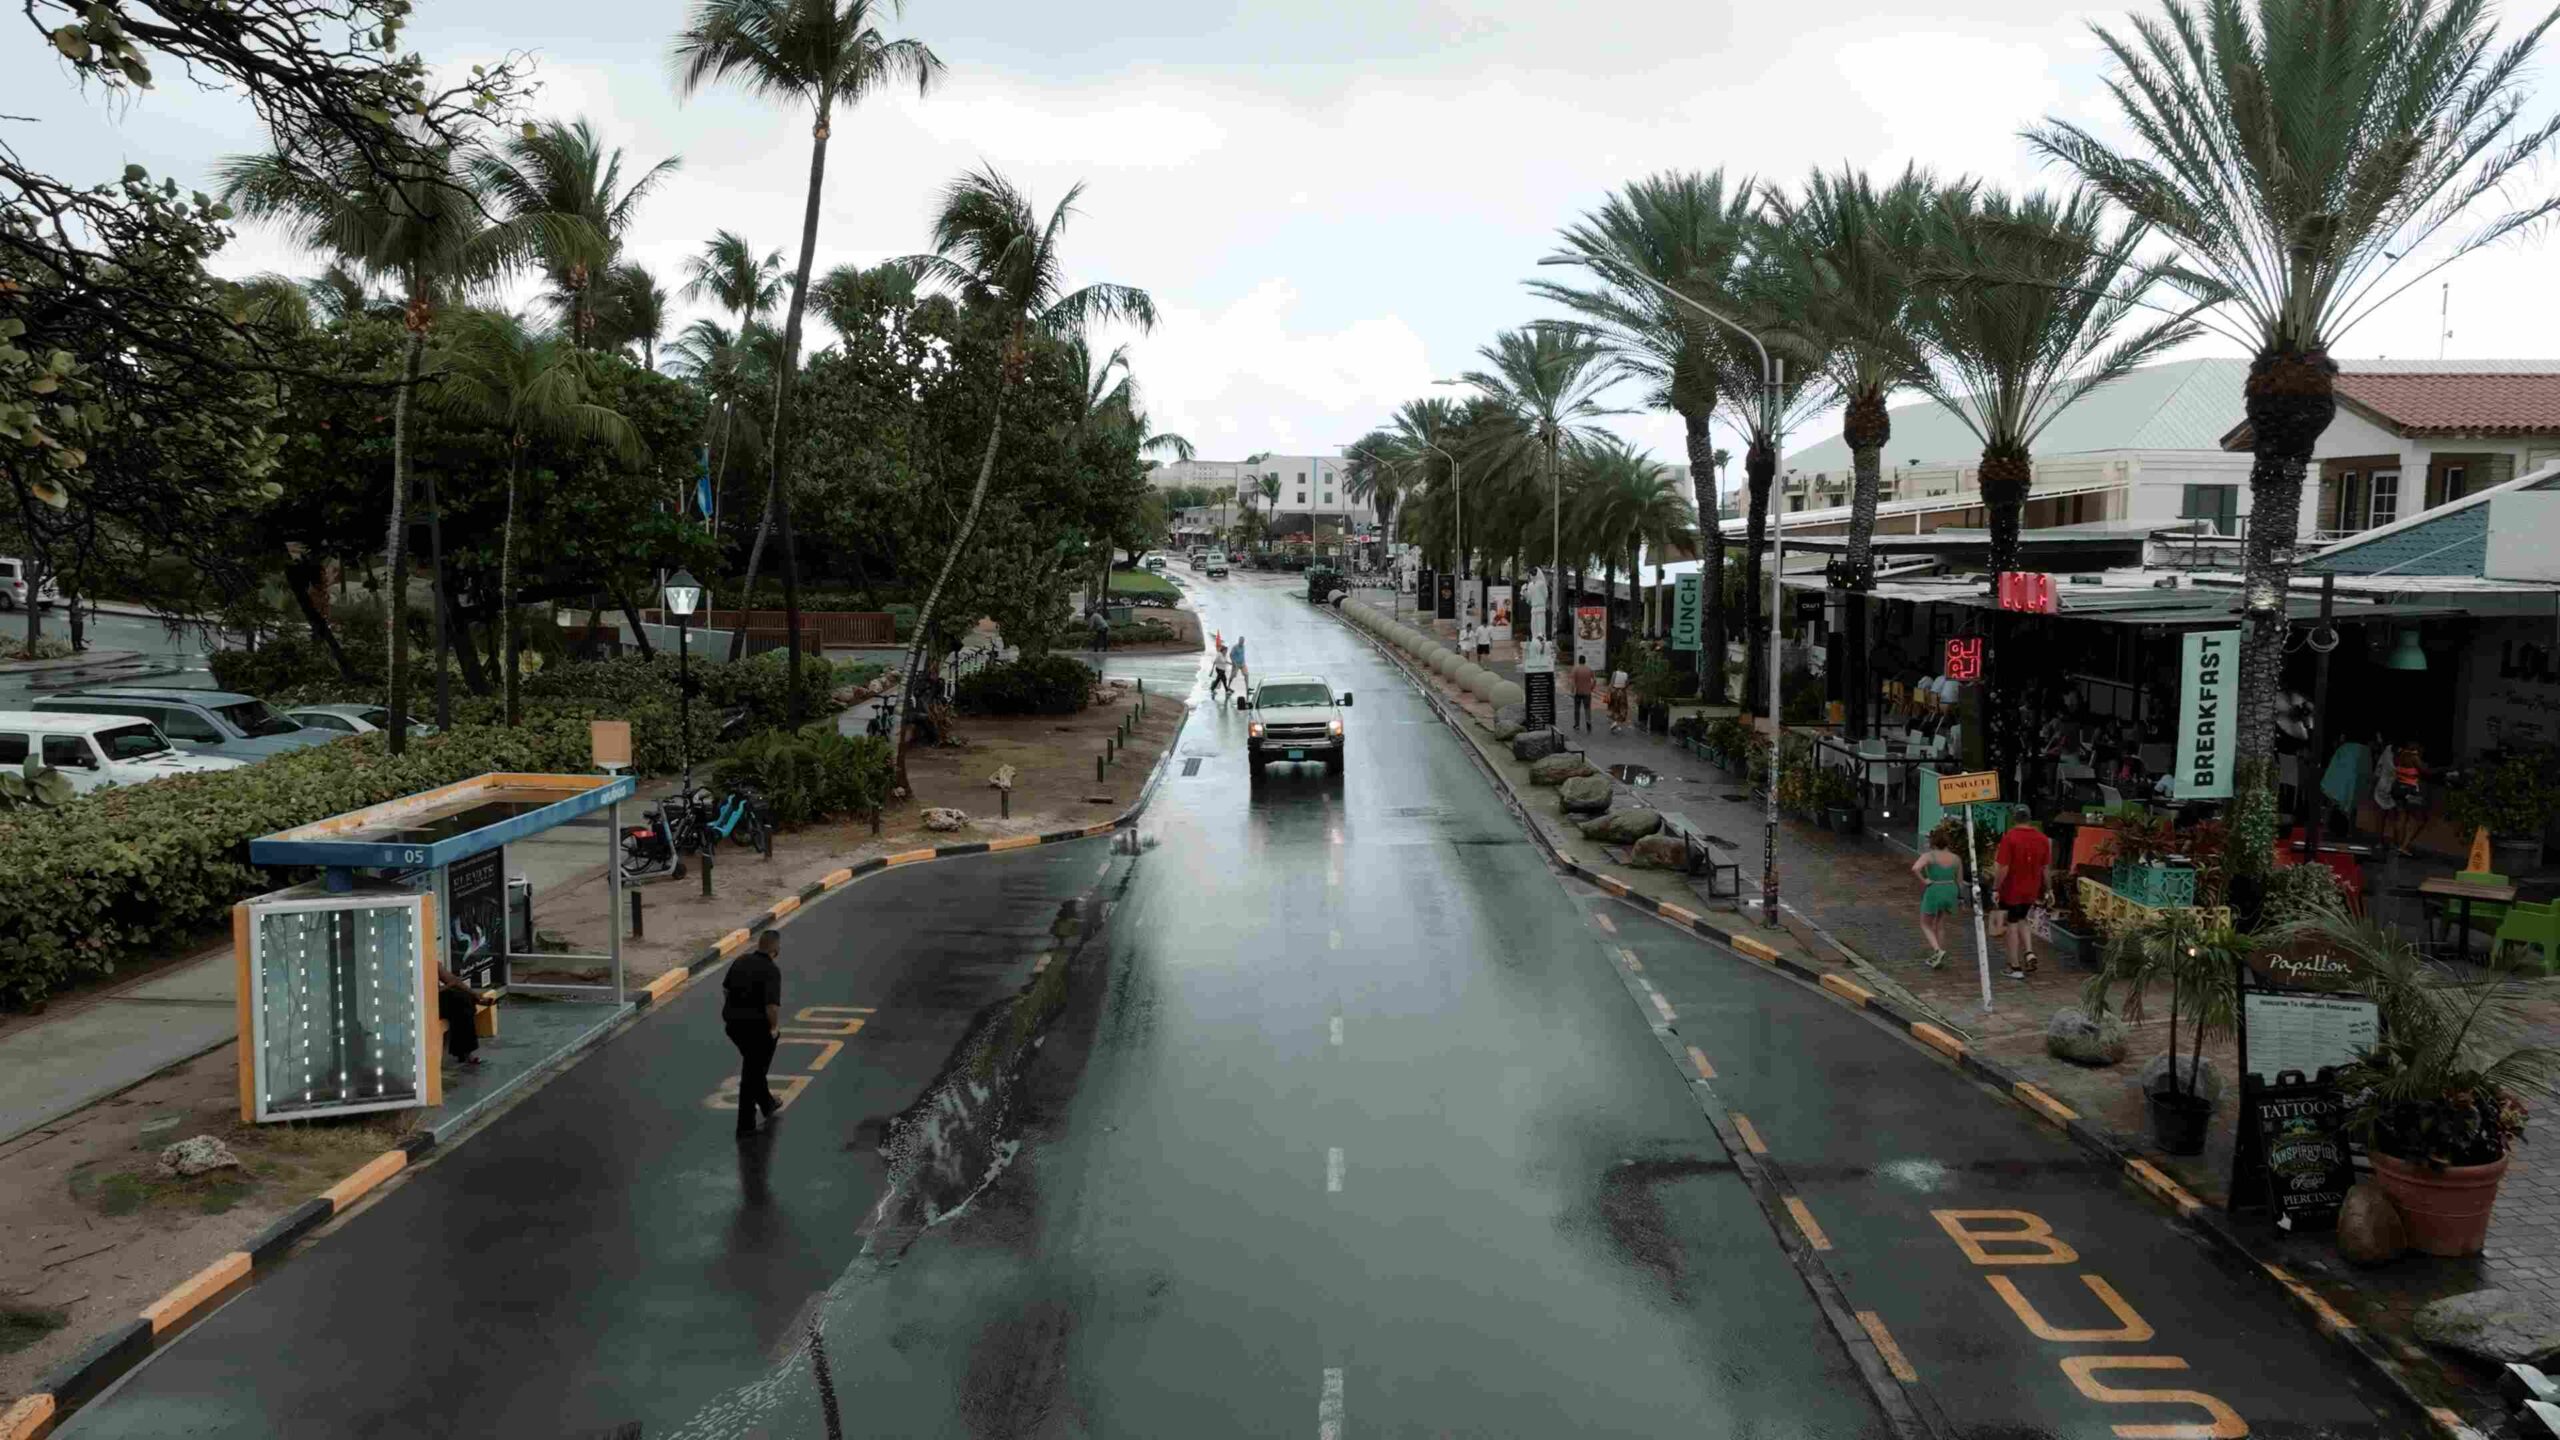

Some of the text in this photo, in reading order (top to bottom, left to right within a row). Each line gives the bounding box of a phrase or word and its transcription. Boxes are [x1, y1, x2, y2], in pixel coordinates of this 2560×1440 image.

[1679, 579, 1697, 645] LUNCH
[2499, 639, 2560, 684] LOL
[2193, 636, 2221, 787] BREAKFAST
[404, 849, 425, 864] 05
[2265, 952, 2352, 977] Papillon
[2259, 1101, 2338, 1118] TATTOOS
[2282, 1191, 2344, 1206] PIERCINGS
[1930, 1209, 2249, 1439] BUS
